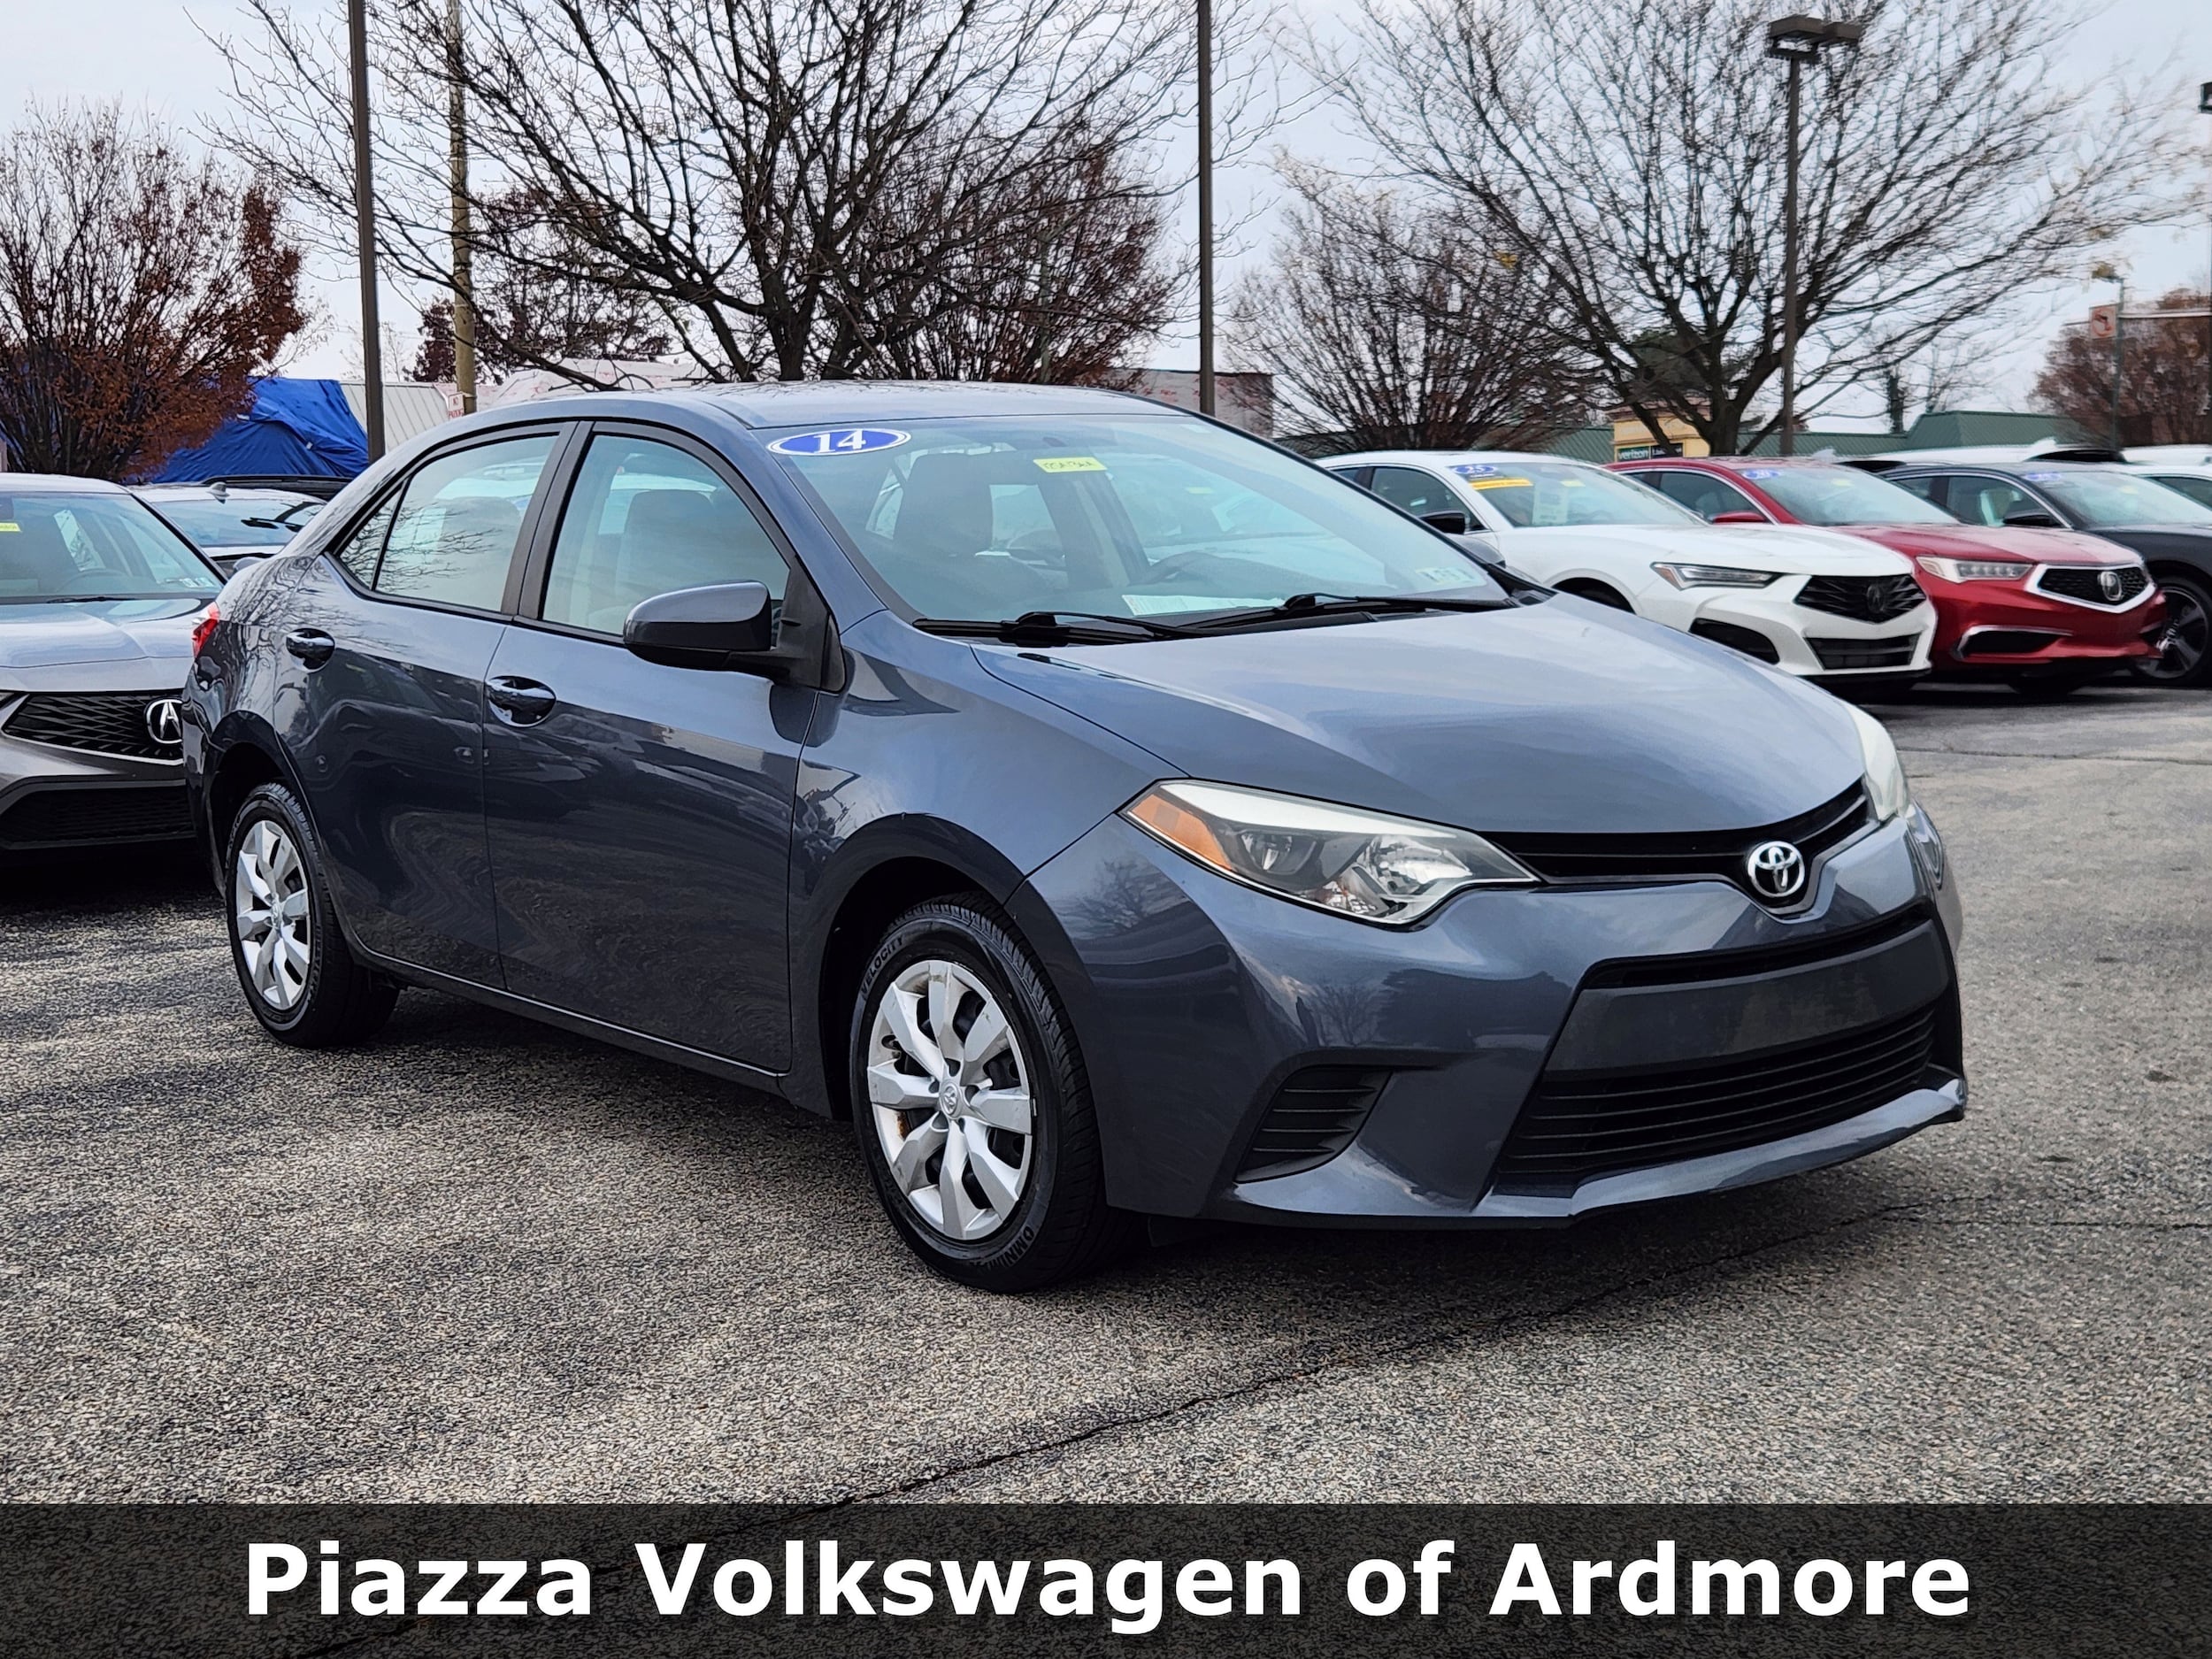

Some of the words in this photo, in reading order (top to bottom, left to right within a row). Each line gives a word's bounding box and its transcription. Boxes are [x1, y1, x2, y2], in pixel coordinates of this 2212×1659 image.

[813, 428, 867, 455] 14
[1618, 449, 1648, 459] verizon
[861, 933, 903, 1002] VELOCITY
